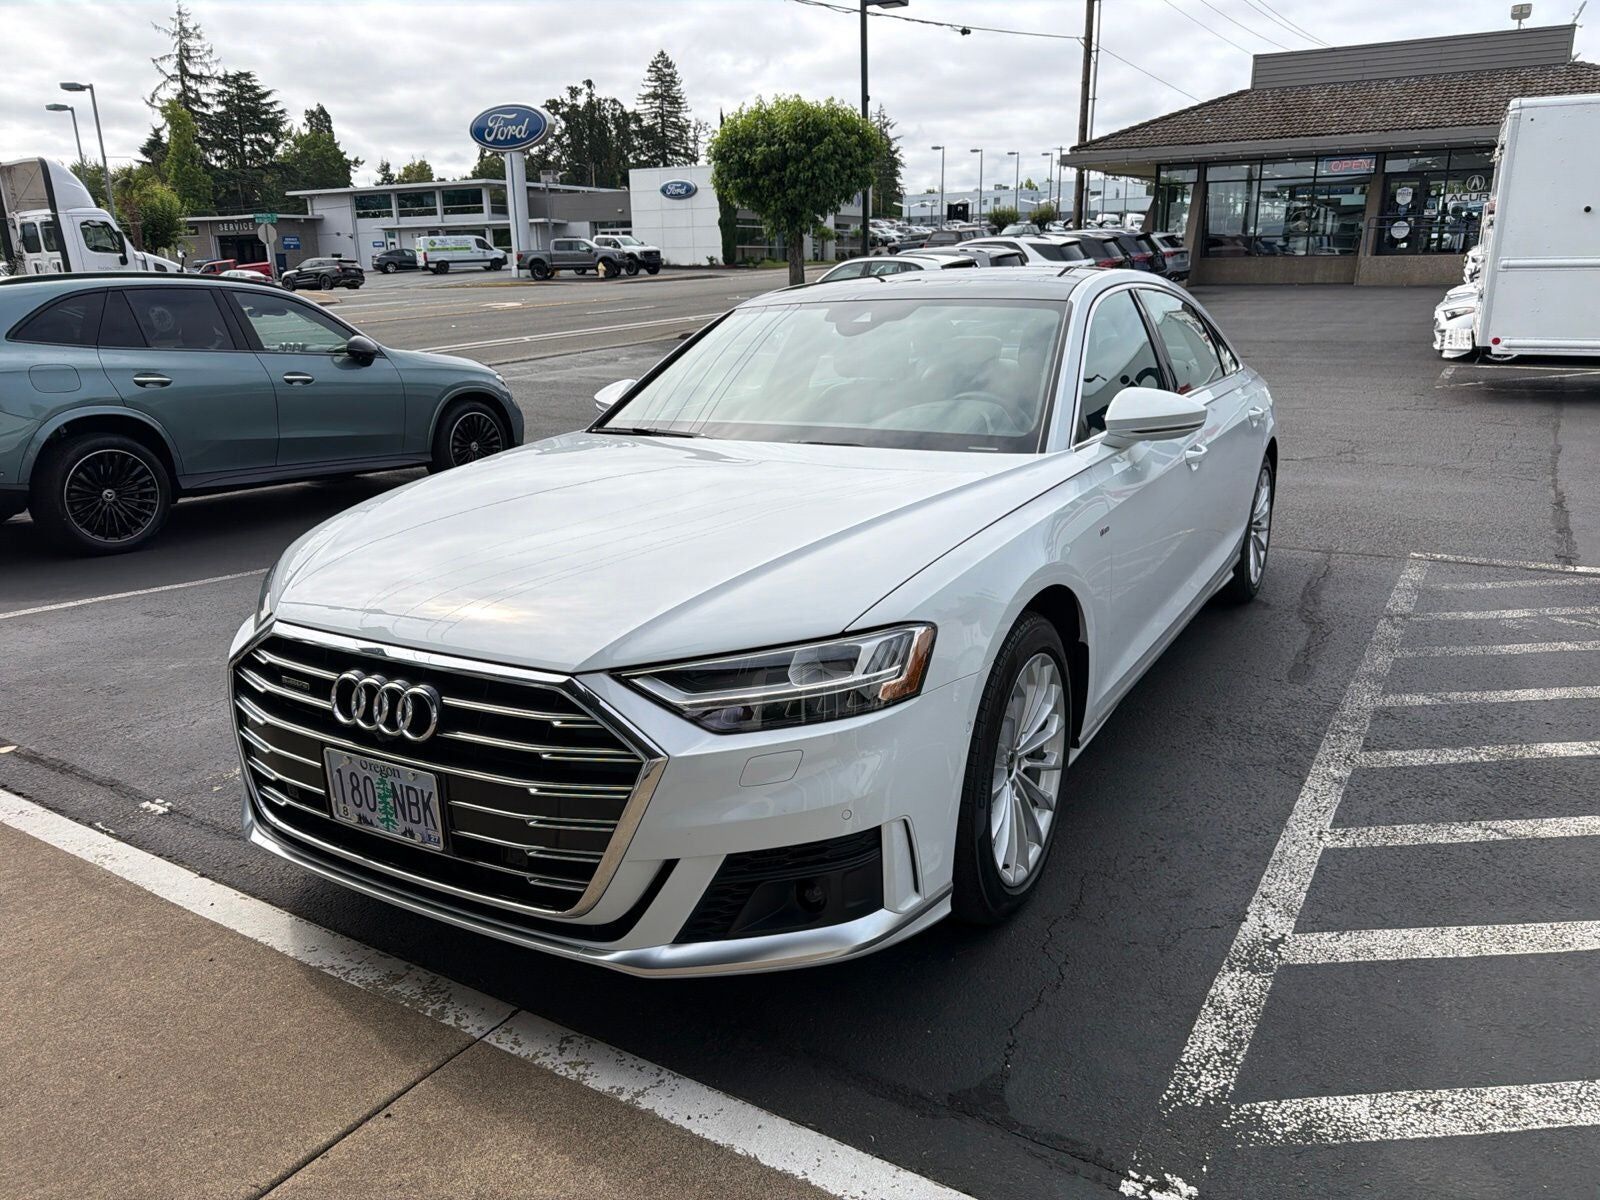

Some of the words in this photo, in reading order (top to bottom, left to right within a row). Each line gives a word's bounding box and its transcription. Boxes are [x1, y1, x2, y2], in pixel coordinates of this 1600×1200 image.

[484, 113, 530, 142] Ford
[1331, 160, 1370, 171] OPEN
[666, 183, 688, 195] Ford
[1448, 193, 1490, 202] ACUR
[218, 222, 254, 231] SERVICE
[360, 759, 401, 779] Oregon
[336, 768, 377, 813] 180
[390, 781, 438, 830] NBK
[342, 805, 349, 817] 8
